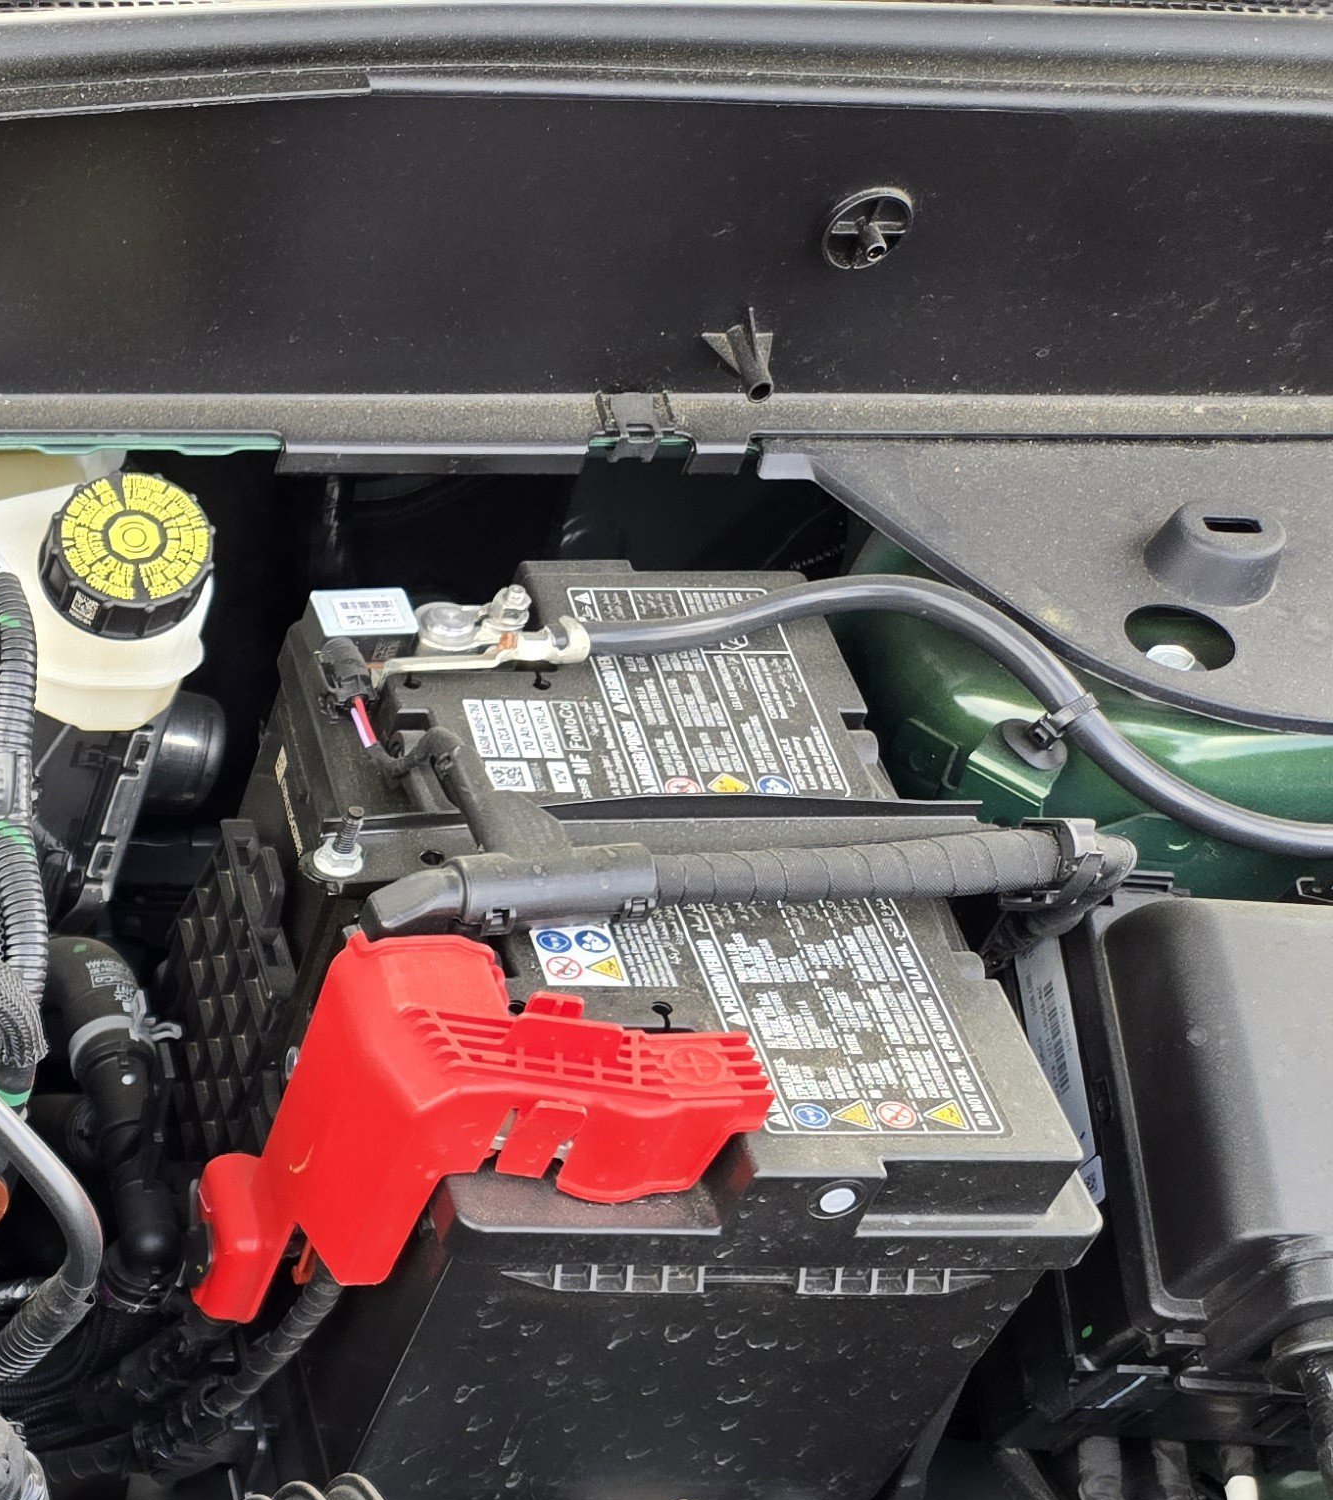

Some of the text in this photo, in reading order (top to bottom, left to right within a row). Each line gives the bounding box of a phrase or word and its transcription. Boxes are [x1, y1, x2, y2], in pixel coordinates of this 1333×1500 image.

[760, 693, 780, 718] CONTRA
[554, 702, 586, 748] FoMoCo
[567, 753, 592, 774] MF
[778, 737, 809, 789] NON-SPILLABLE
[788, 736, 808, 758] Battery
[798, 759, 812, 772] Acid
[829, 773, 845, 789] ANTI
[891, 942, 930, 992] NO LA ABRA.
[917, 996, 962, 1062] NE PAS OUVRIR.
[950, 1066, 993, 1126] DO NOT OPEN.
